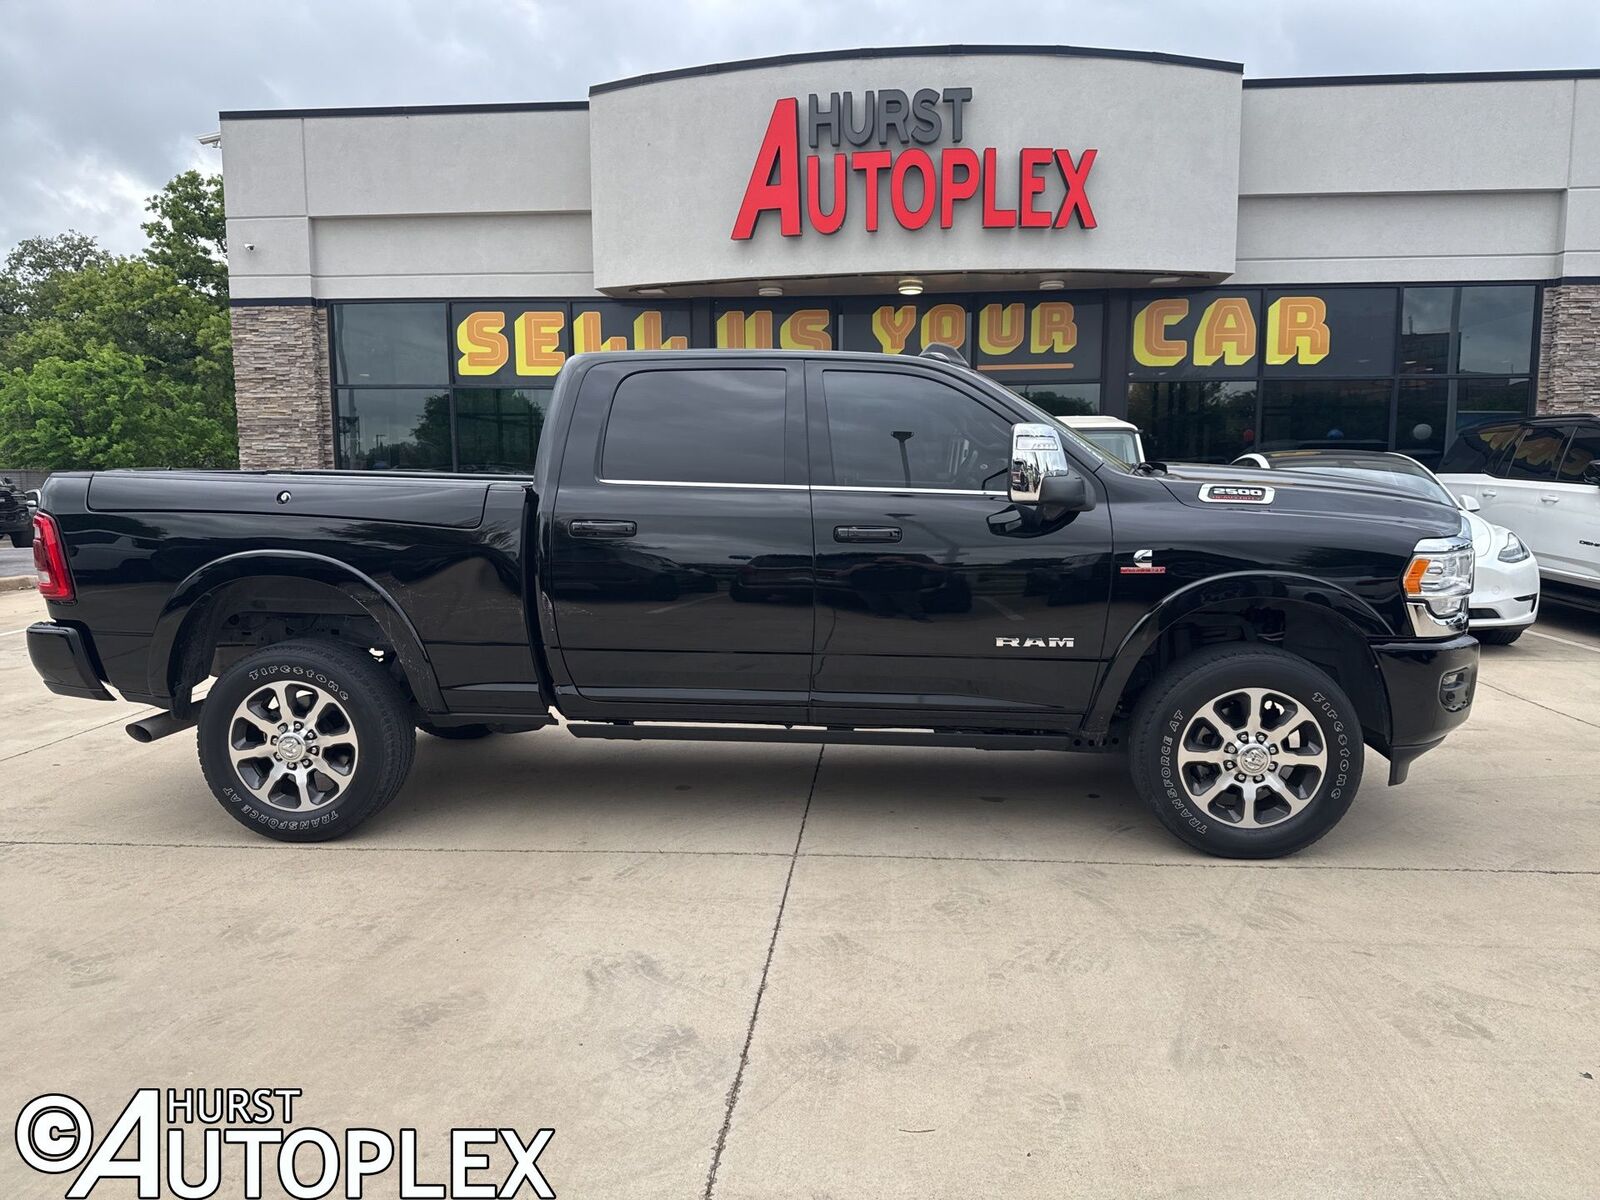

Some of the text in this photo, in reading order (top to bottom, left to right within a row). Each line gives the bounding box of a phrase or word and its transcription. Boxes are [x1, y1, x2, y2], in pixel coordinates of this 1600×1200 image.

[808, 87, 973, 148] HURST
[731, 97, 1098, 240] AUTOPLEX
[872, 302, 1077, 355] YOUR
[1133, 296, 1331, 366] CAR
[1213, 488, 1263, 496] 2500
[995, 637, 1075, 648] RAM
[1160, 709, 1207, 835] TRANSFORCE AT
[223, 786, 339, 830] TRANSFORCE AT
